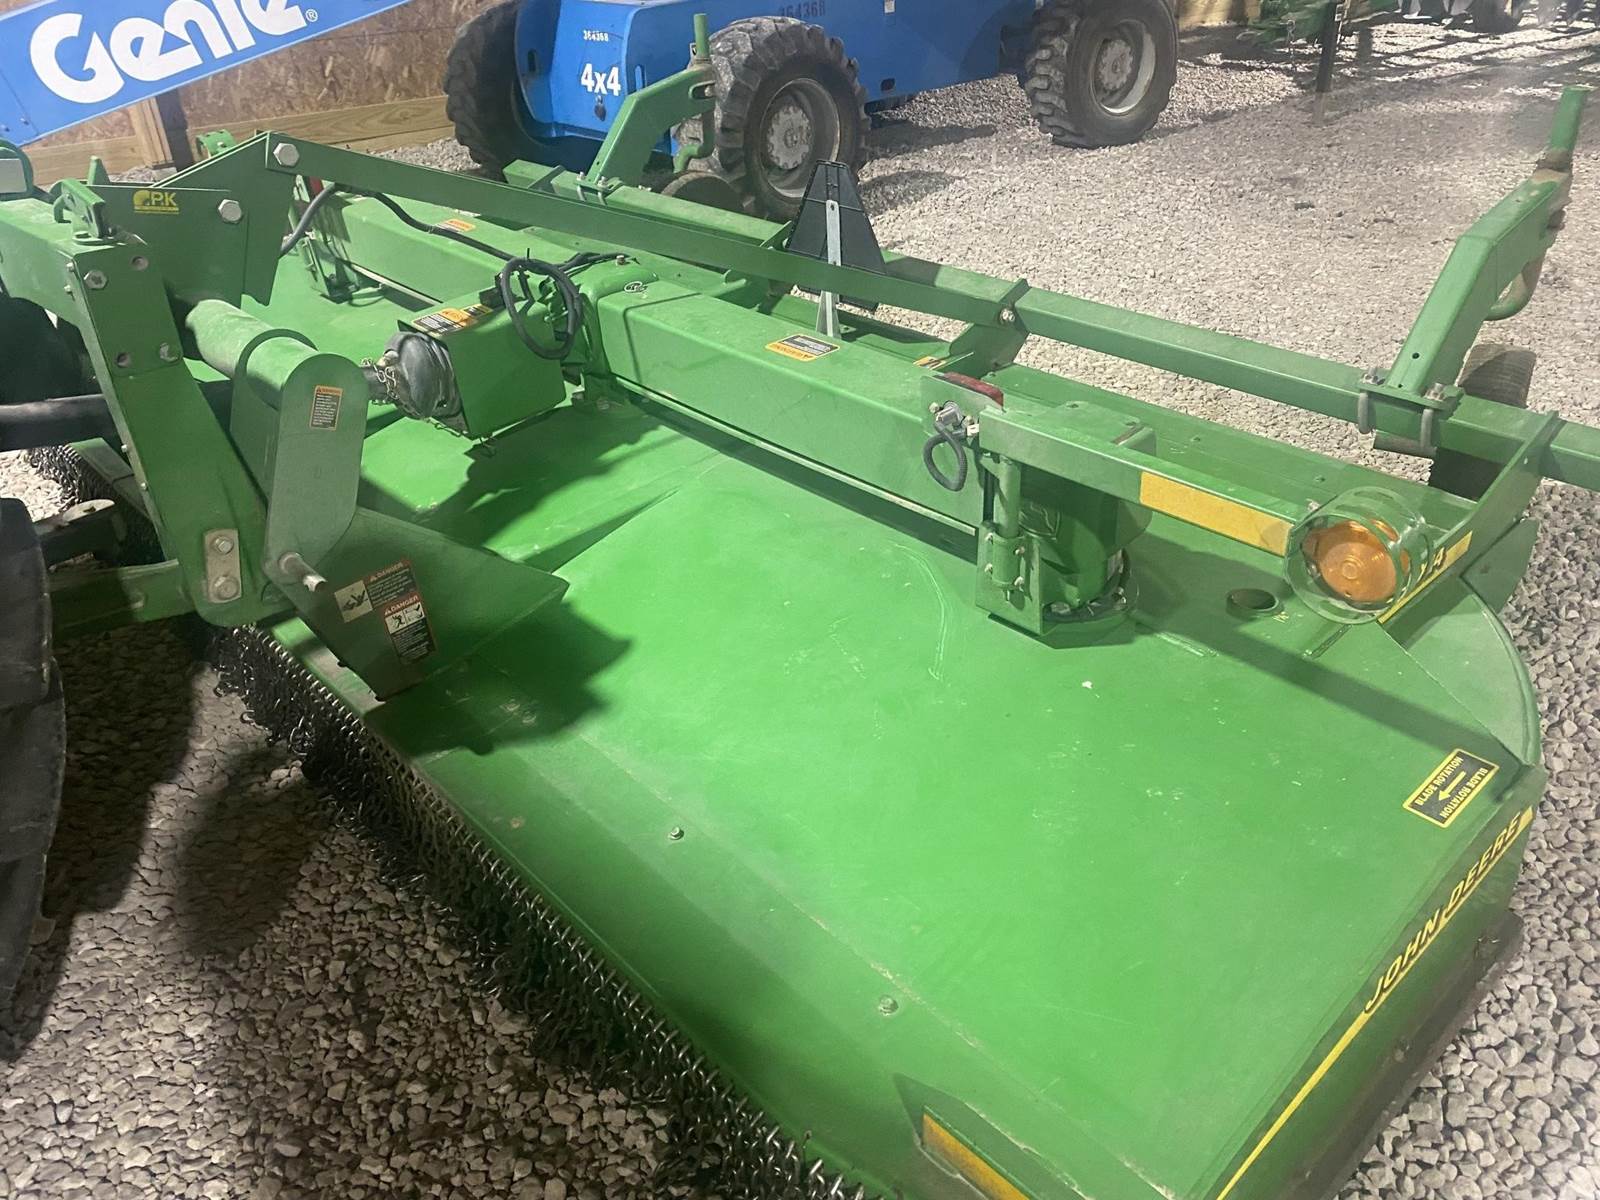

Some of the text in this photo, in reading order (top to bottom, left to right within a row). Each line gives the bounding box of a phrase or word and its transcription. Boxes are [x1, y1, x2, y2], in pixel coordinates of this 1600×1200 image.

[581, 63, 621, 96] 4x4
[1414, 756, 1464, 806] BLADE ROTATION
[1439, 767, 1489, 818] BLADE ROTATION
[1364, 811, 1522, 1013] JOHN DEERE
